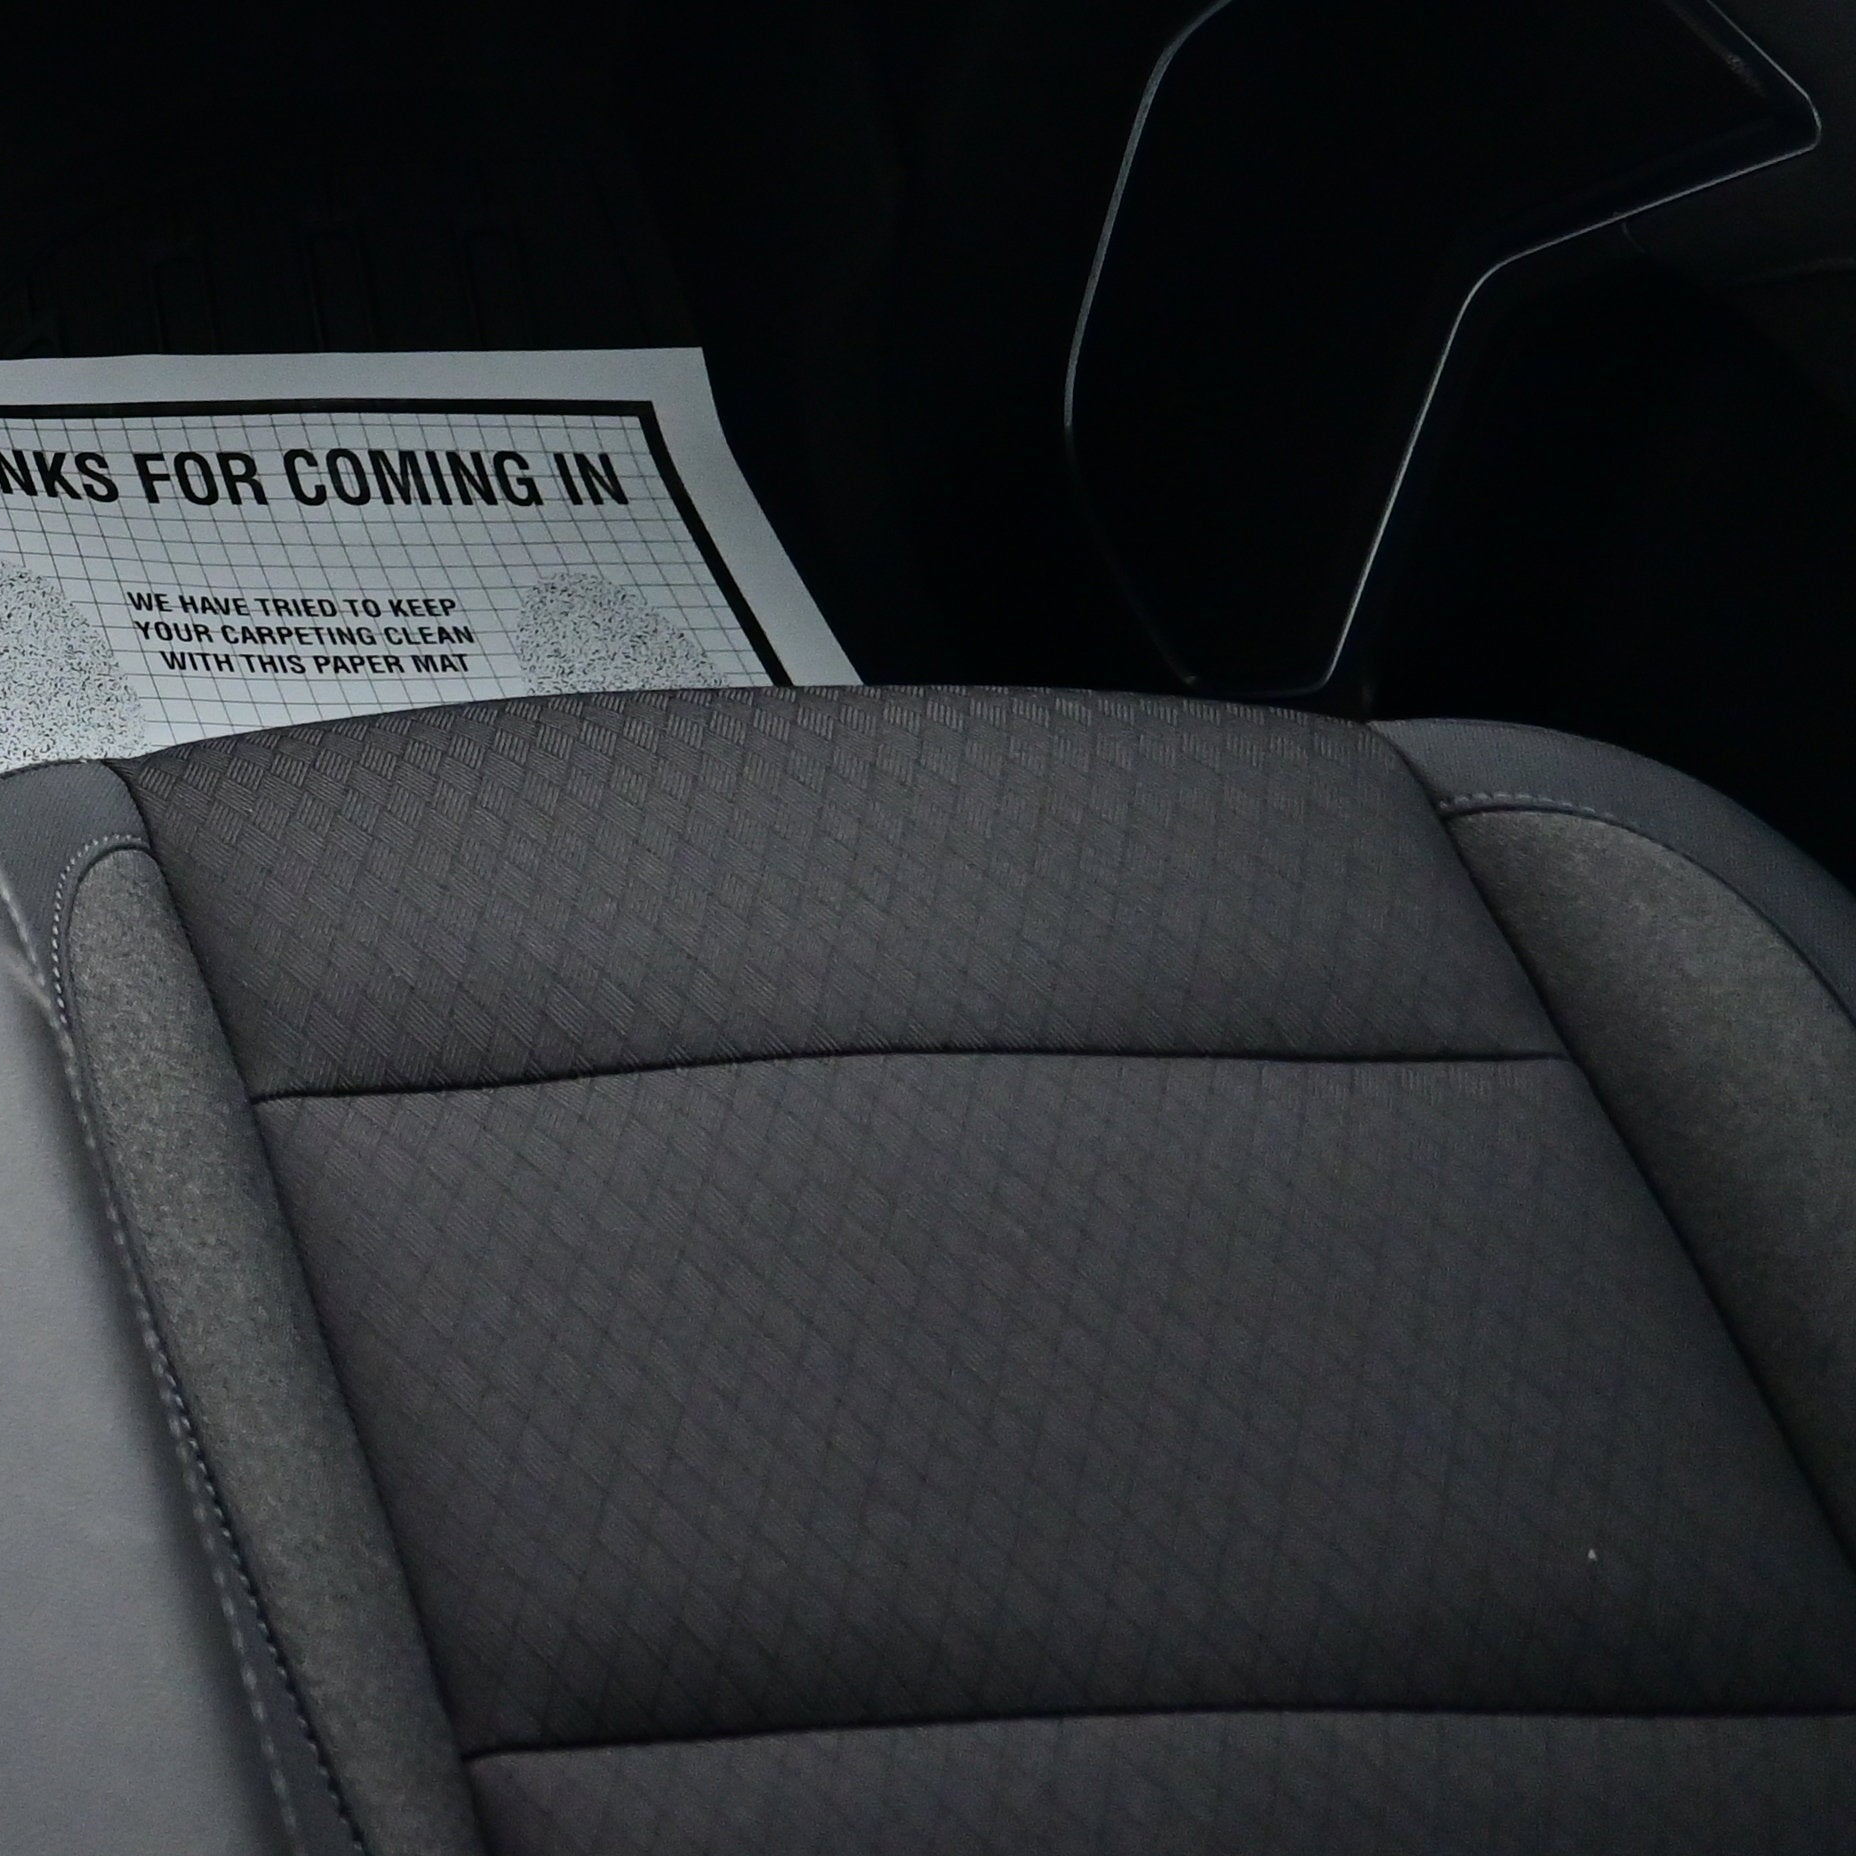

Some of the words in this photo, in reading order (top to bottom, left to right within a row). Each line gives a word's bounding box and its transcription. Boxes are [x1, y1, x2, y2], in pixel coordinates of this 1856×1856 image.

[133, 451, 270, 507] FOR
[284, 447, 541, 508] COMING
[555, 453, 631, 506] IN
[127, 592, 173, 613] WE
[178, 595, 251, 616] HAVE
[253, 597, 339, 618] TRIED
[345, 598, 381, 618] TO
[388, 598, 456, 618] KEEP
[134, 621, 213, 643] YOUR
[221, 624, 377, 645] CARPETING
[383, 626, 475, 645] CLEAN
[159, 651, 235, 673] WITH
[240, 653, 306, 674] THIS
[313, 655, 406, 674] PAPER
[411, 654, 471, 673] MAT
